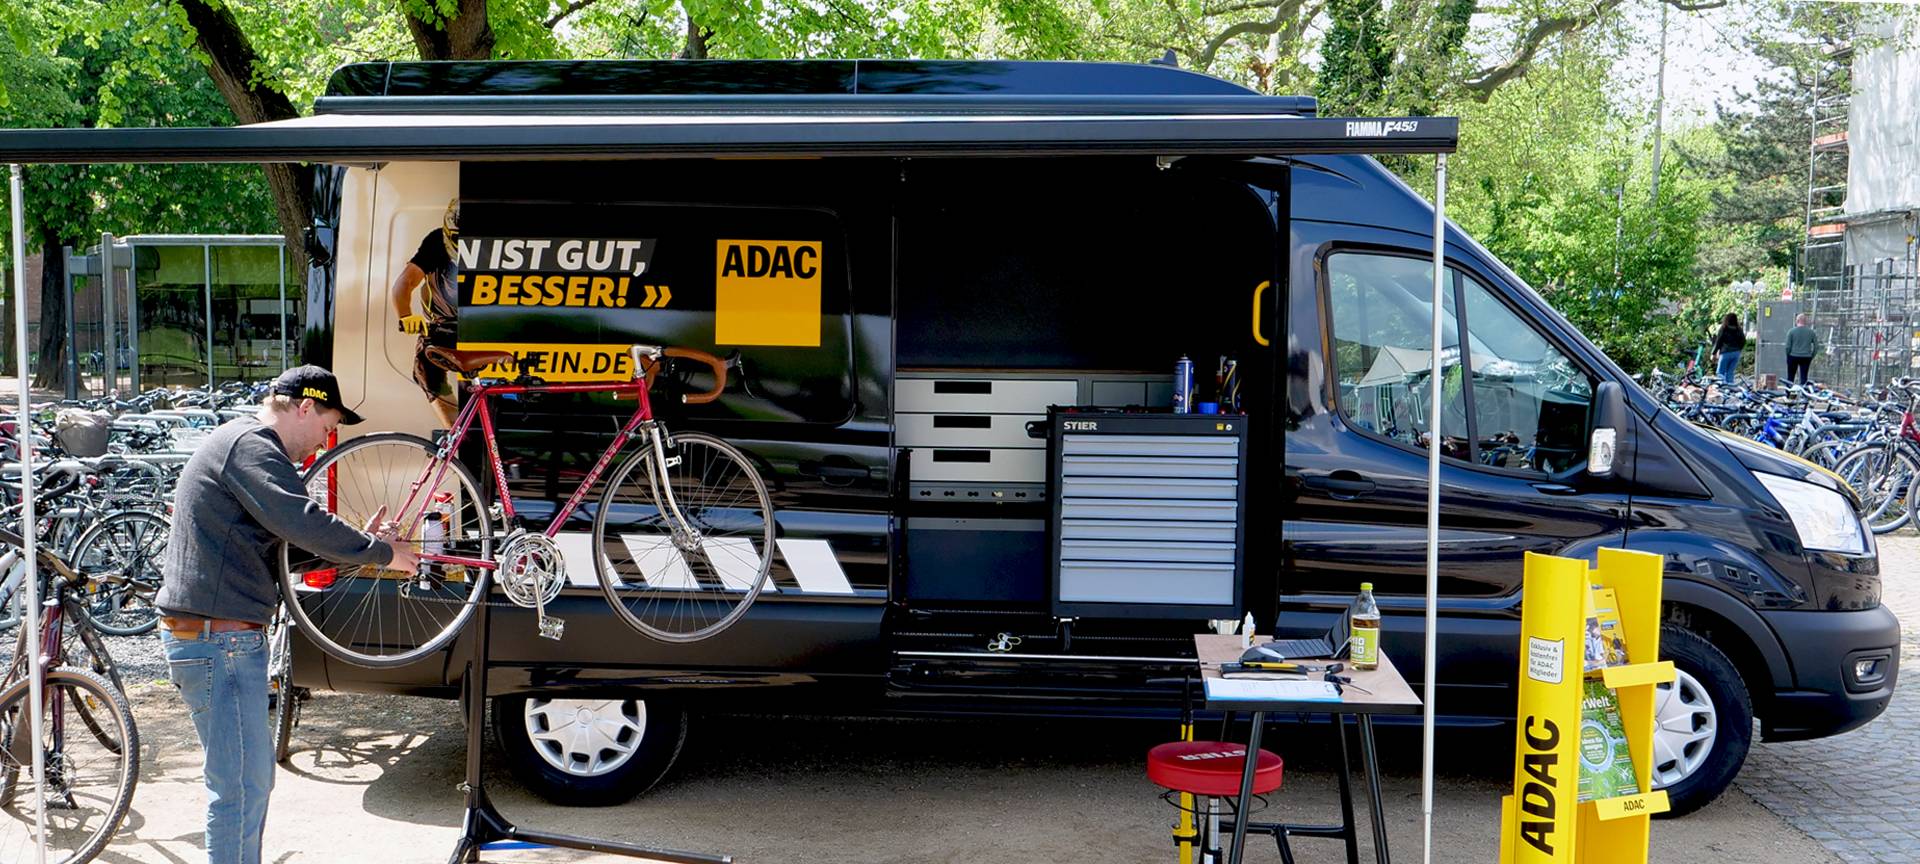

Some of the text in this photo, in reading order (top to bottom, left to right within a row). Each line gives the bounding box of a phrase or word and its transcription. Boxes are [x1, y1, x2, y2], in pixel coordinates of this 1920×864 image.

[1346, 121, 1382, 137] FIAMMA
[488, 239, 551, 270] IST
[556, 240, 646, 277] GUT,
[721, 244, 818, 280] ADAC
[471, 274, 631, 308] BESSER!
[302, 387, 328, 401] ADAC
[1063, 420, 1098, 431] STIER
[1537, 660, 1555, 669] ADAC
[1520, 715, 1561, 857] ADAC
[1623, 798, 1646, 812] ADAC
